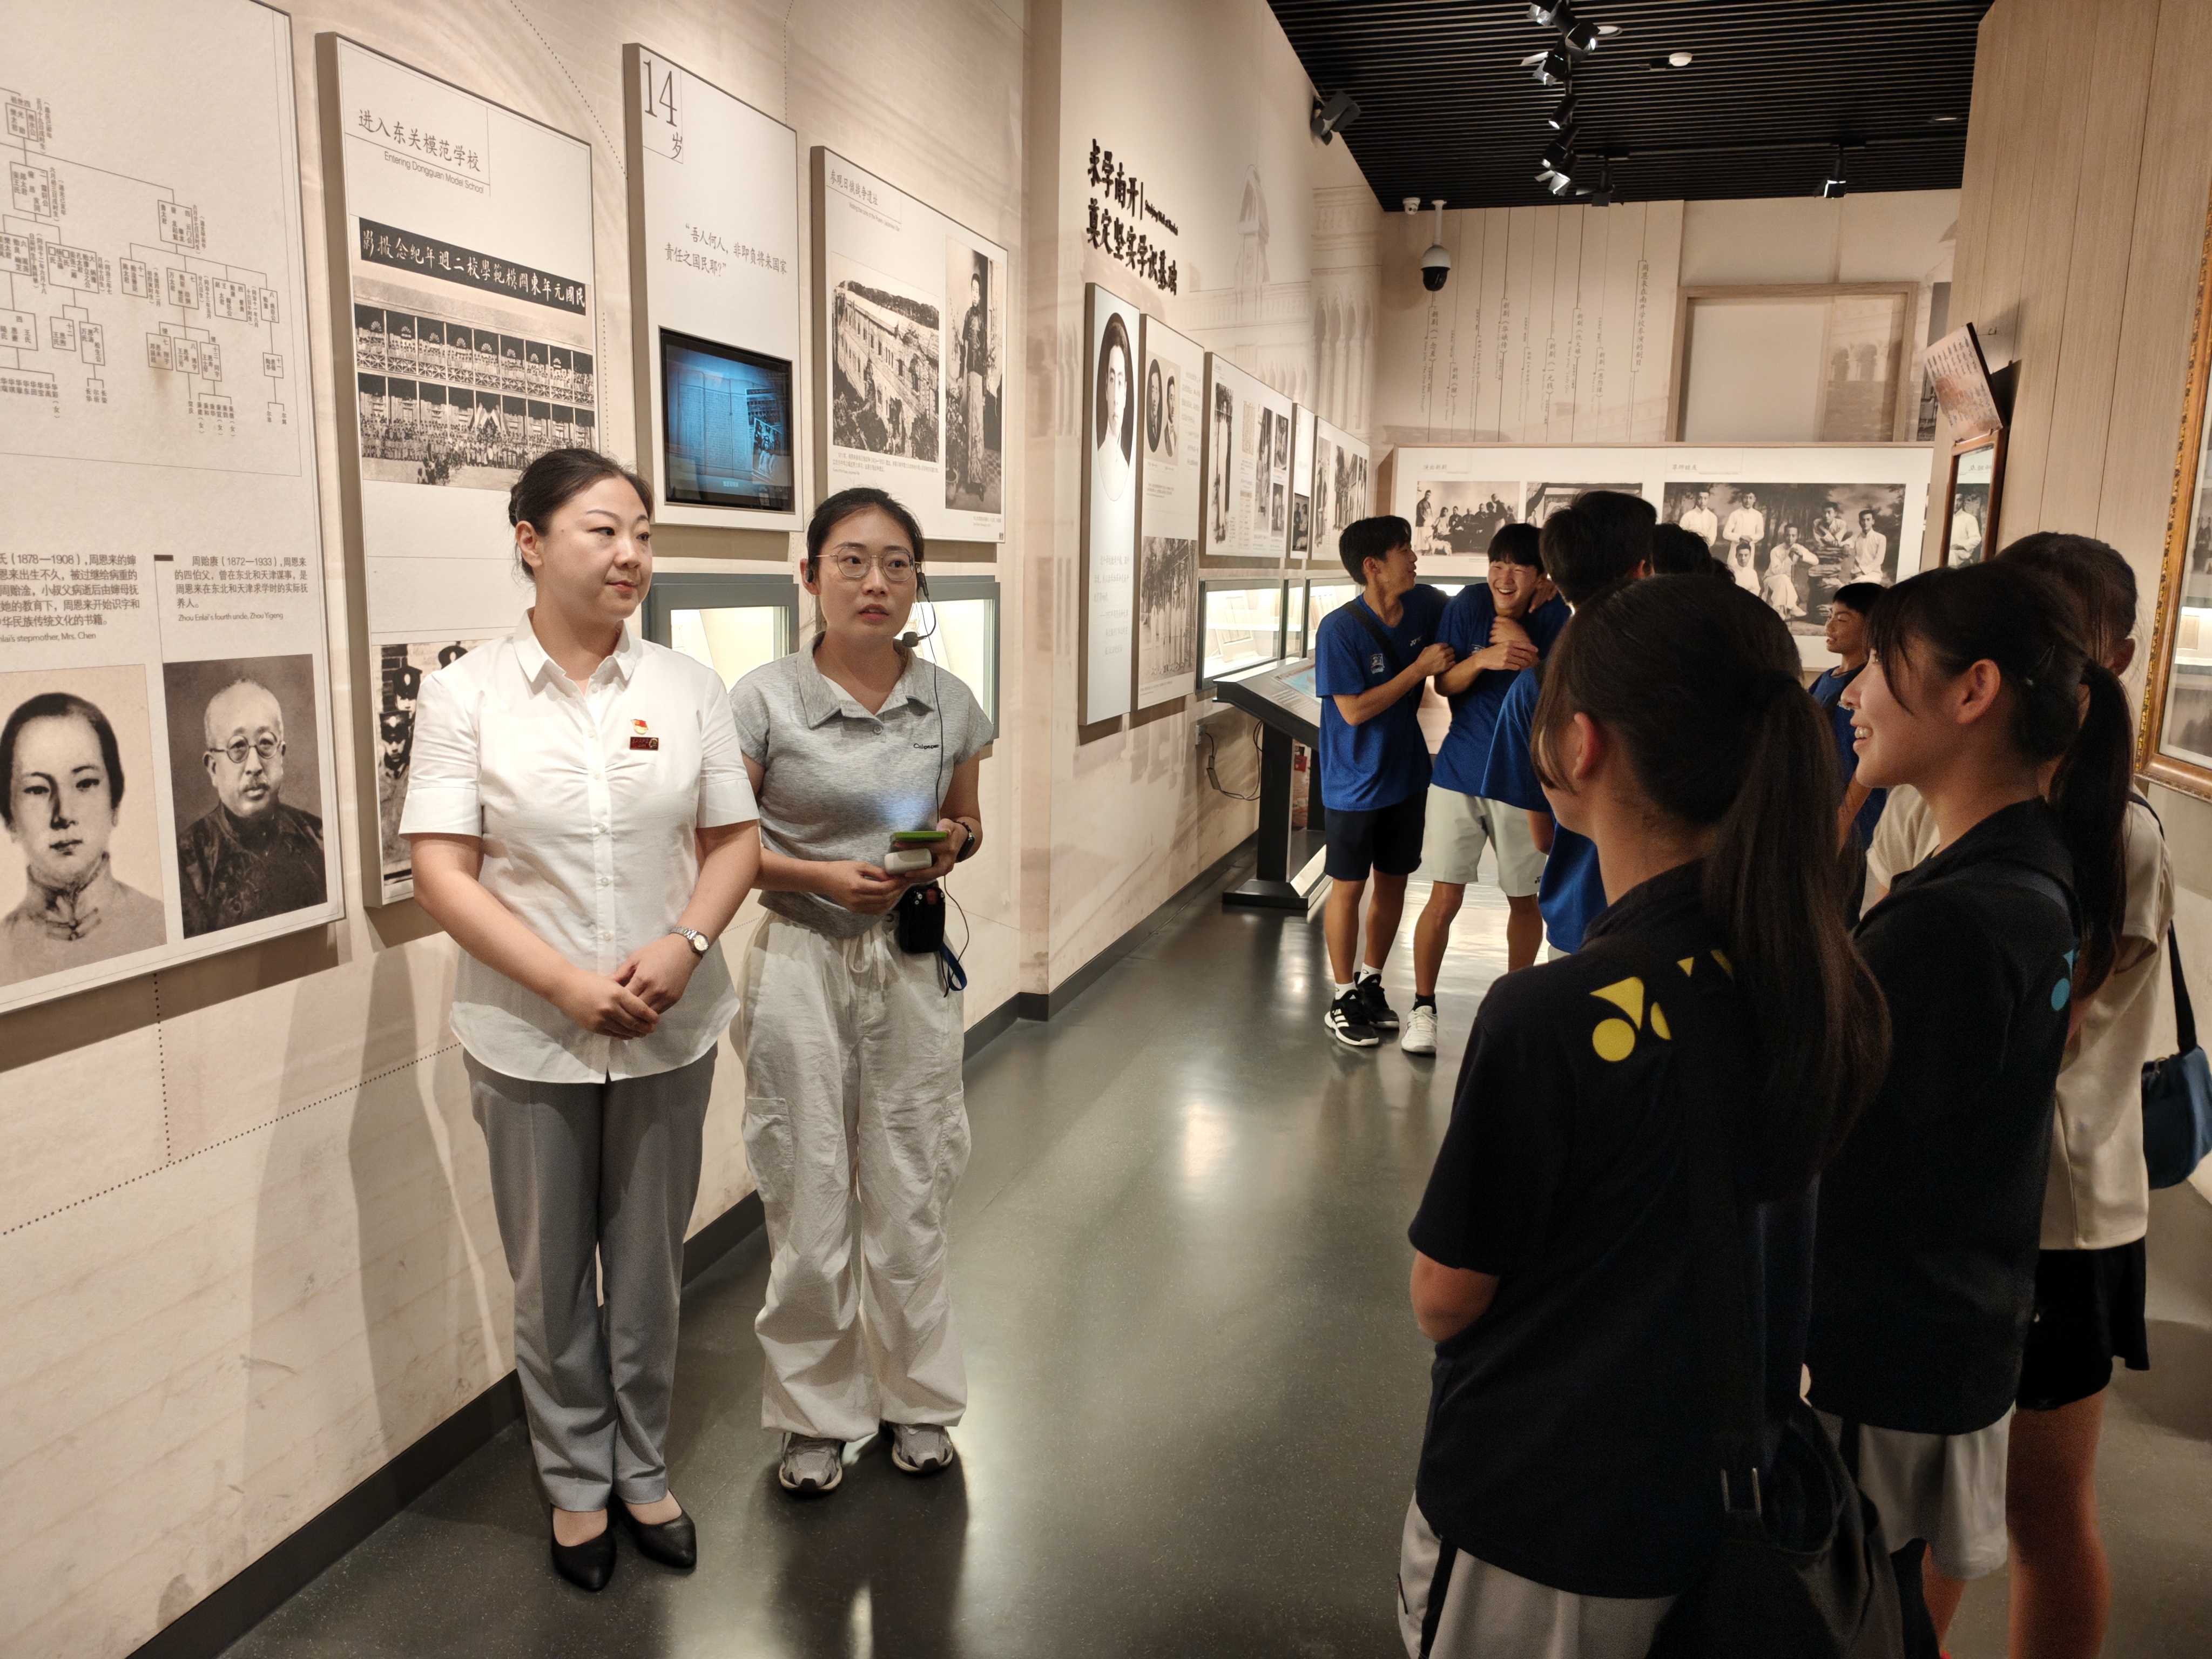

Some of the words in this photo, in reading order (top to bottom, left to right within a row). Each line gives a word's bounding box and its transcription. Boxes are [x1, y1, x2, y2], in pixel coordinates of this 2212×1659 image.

[643, 59, 677, 127] 14
[359, 109, 481, 172] 进入东关模范学校
[671, 132, 683, 159] 岁
[384, 151, 411, 170] Entering
[412, 160, 444, 180] Dongguan
[446, 173, 463, 187] Model
[464, 179, 484, 194] School
[30, 381, 37, 395] 华田
[176, 583, 308, 594] 周恩来在东北和天津求学时的实际抚
[0, 599, 140, 612] 她的教育下，周恩来开始识字和
[177, 597, 199, 609] 养人。
[0, 613, 107, 628] 华民族传统文化的书籍。
[264, 611, 284, 621] Yigeng
[17, 633, 60, 643] stepmother,
